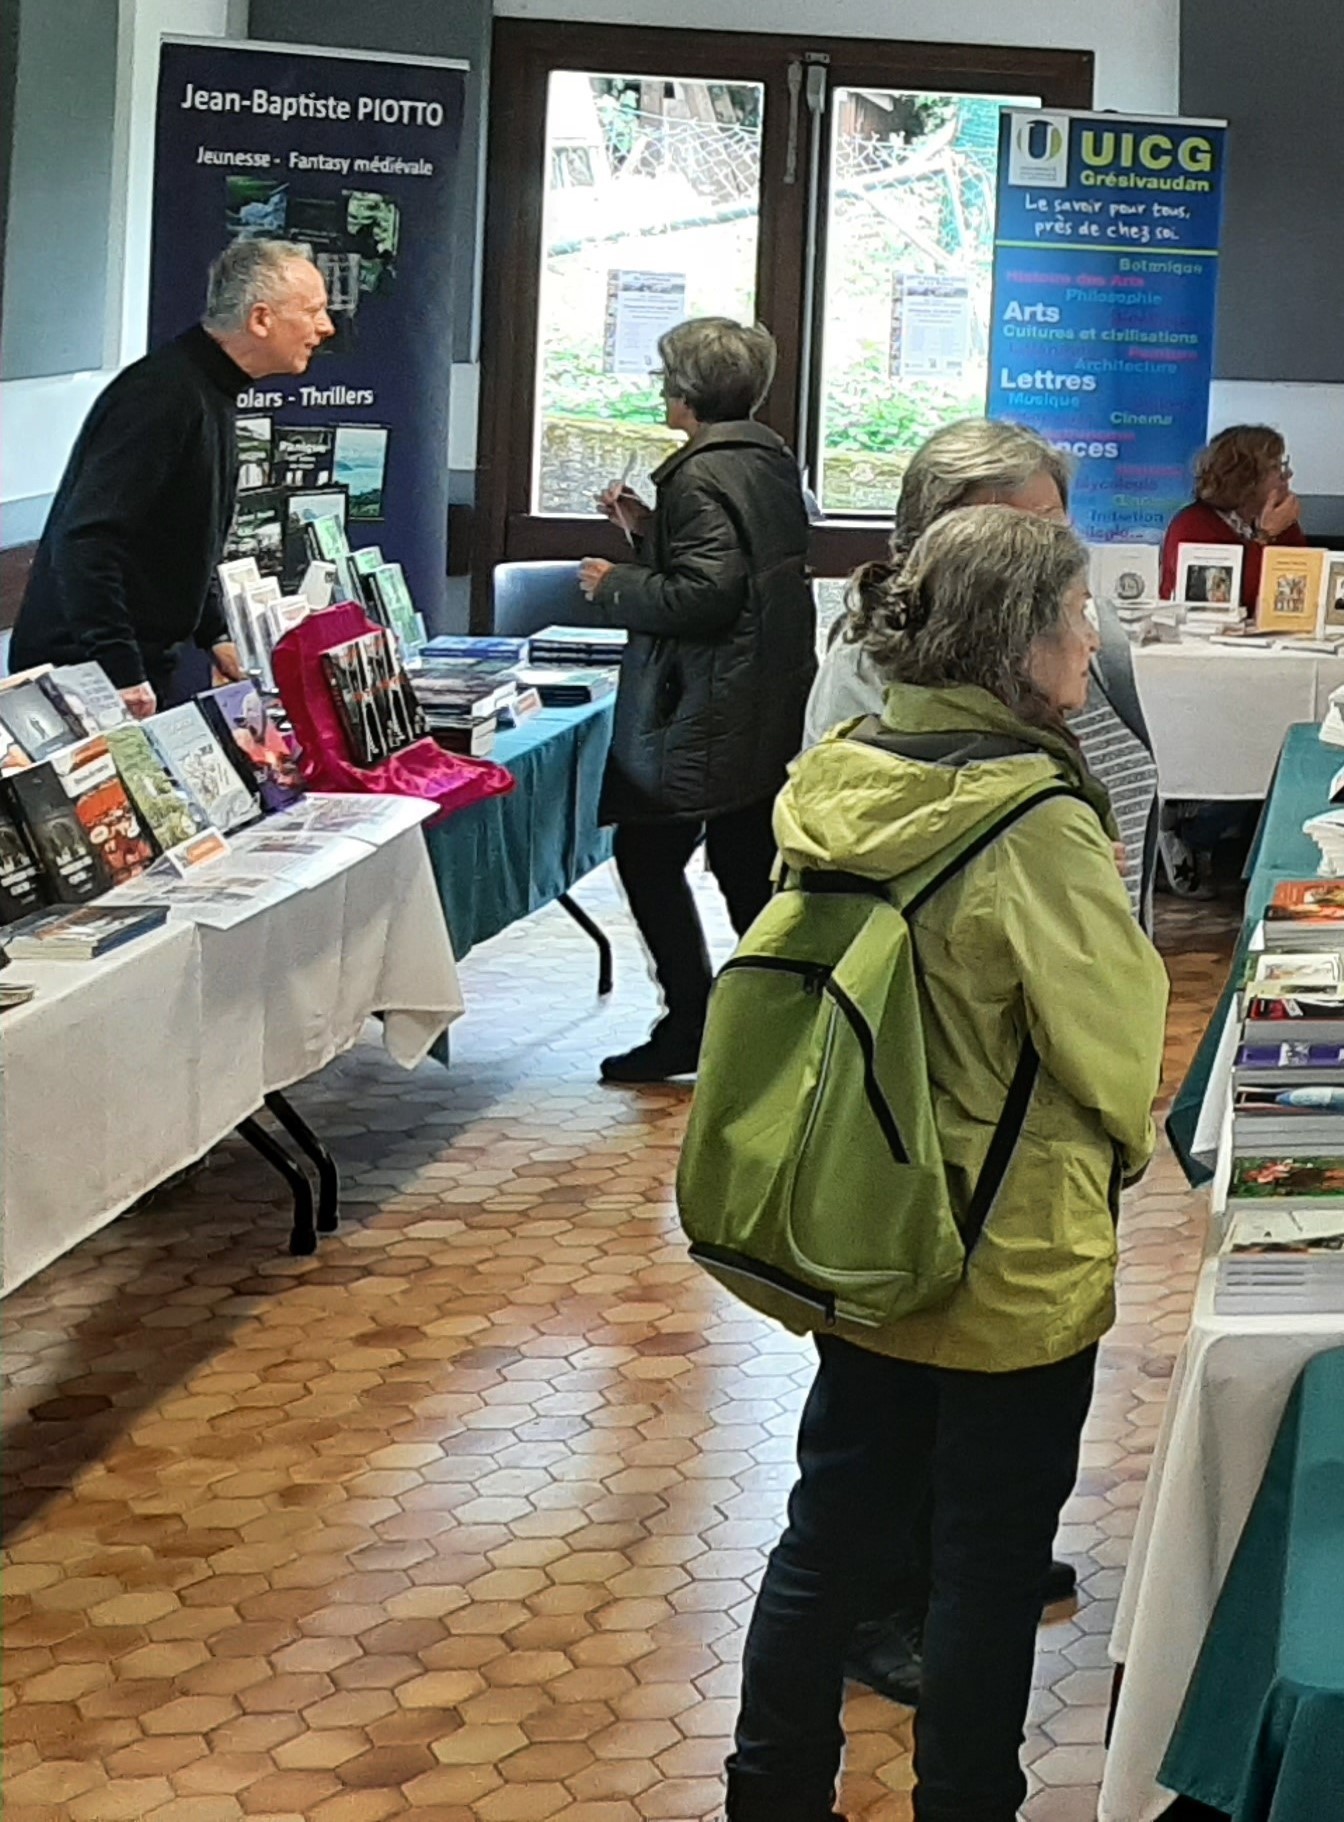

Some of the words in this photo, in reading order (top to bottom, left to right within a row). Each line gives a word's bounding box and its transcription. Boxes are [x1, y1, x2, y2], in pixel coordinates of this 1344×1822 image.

[181, 83, 350, 121] Jean-Baptiste
[358, 97, 444, 126] PIOTTO
[197, 146, 271, 168] Jeunesse
[289, 152, 350, 175] Fantasy
[354, 154, 433, 176] médiévale
[1081, 130, 1212, 172] UICG
[1080, 170, 1210, 192] Grésivaudan
[1025, 193, 1048, 212] Le
[1054, 199, 1102, 214] savoir
[1109, 203, 1146, 218] pour
[1035, 215, 1072, 237] près
[1079, 220, 1100, 237] de
[1107, 221, 1150, 243] chez
[1119, 258, 1203, 276] Botanique
[1112, 274, 1145, 288] Arts
[1065, 288, 1162, 306] Philosophie
[1003, 301, 1060, 323] Arts
[1003, 325, 1074, 340] Cultures
[1080, 327, 1097, 340] et
[1102, 328, 1199, 344] civilisations
[1074, 357, 1178, 374] Architecture
[1001, 367, 1097, 391] Lettres
[236, 388, 283, 408] olars
[300, 386, 374, 407] Thrillers
[1007, 393, 1080, 409] Musique
[1054, 440, 1119, 459] nces
